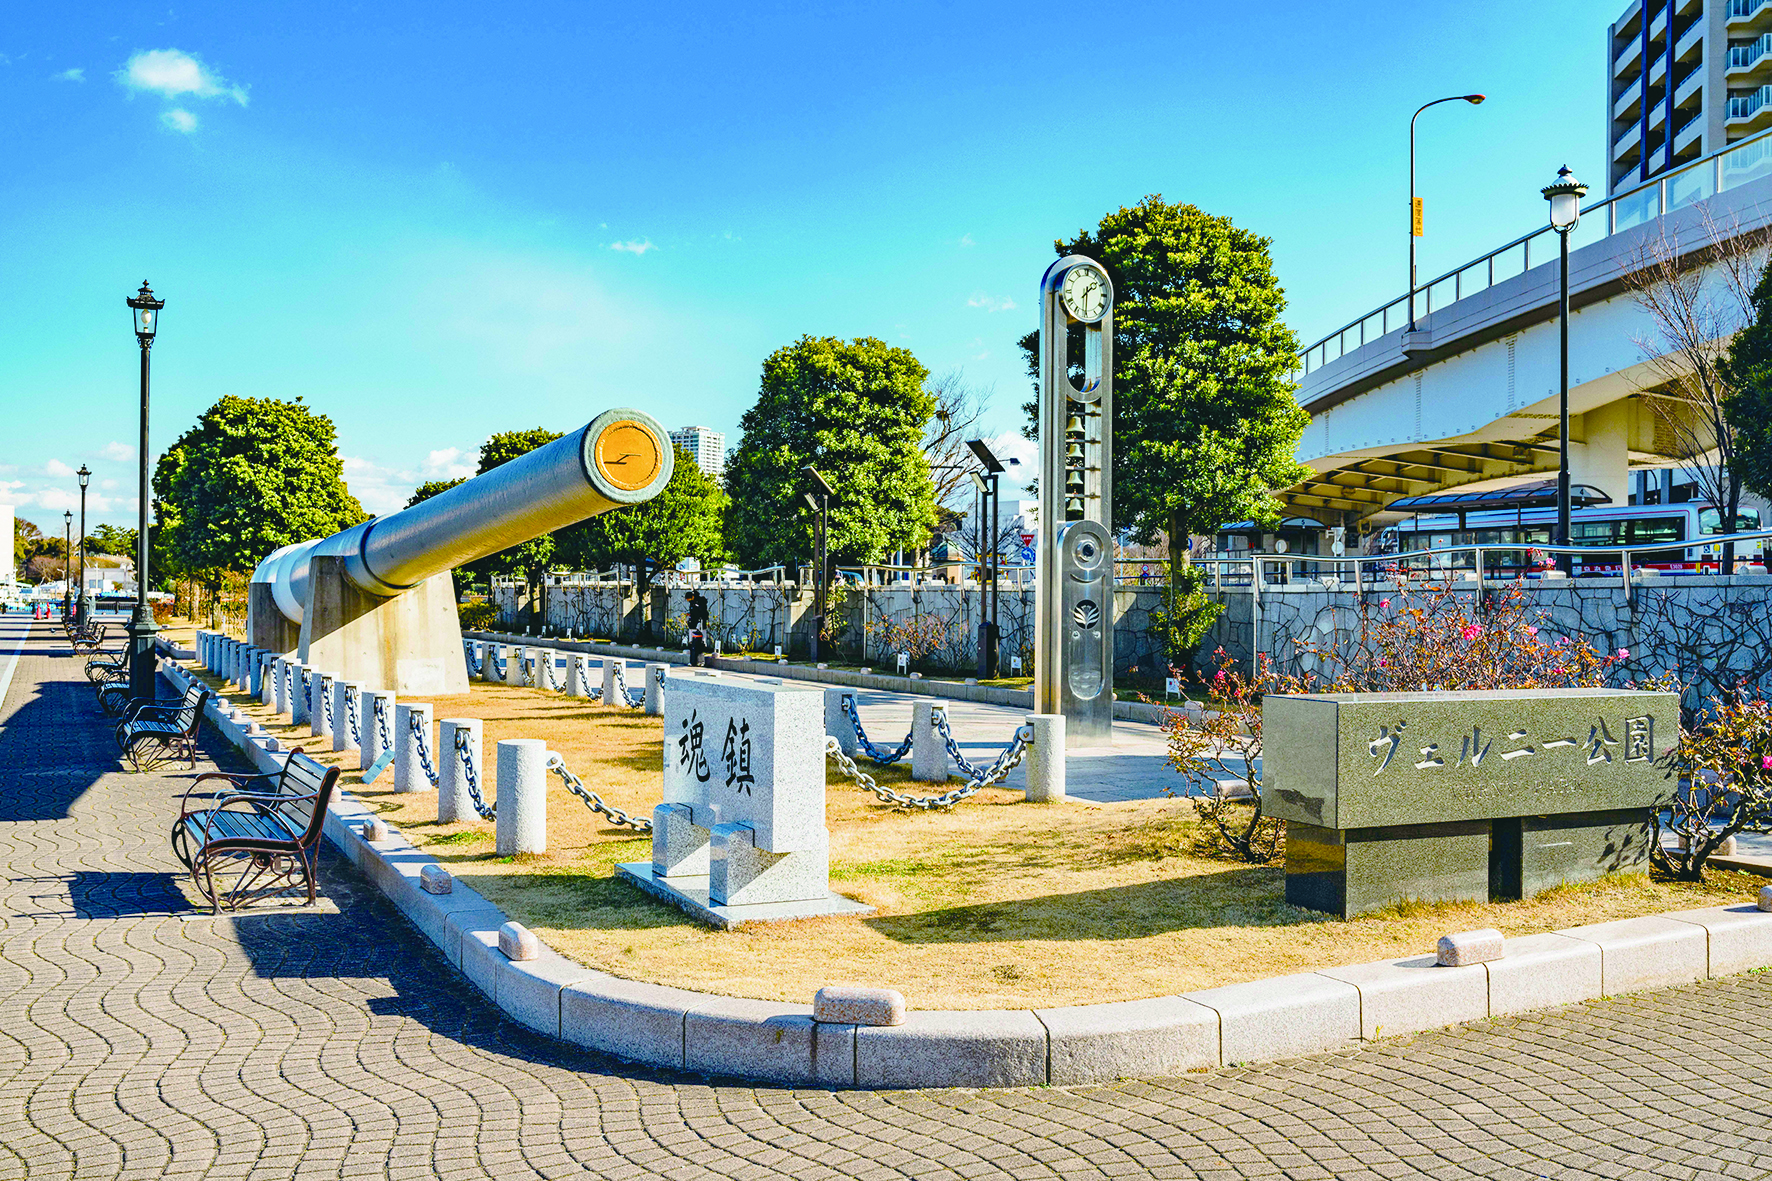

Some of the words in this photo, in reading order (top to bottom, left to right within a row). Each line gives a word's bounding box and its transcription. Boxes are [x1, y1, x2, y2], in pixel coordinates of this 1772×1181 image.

[1368, 713, 1656, 777] ヴェルニー公園
[1533, 778, 1584, 796] PARK
